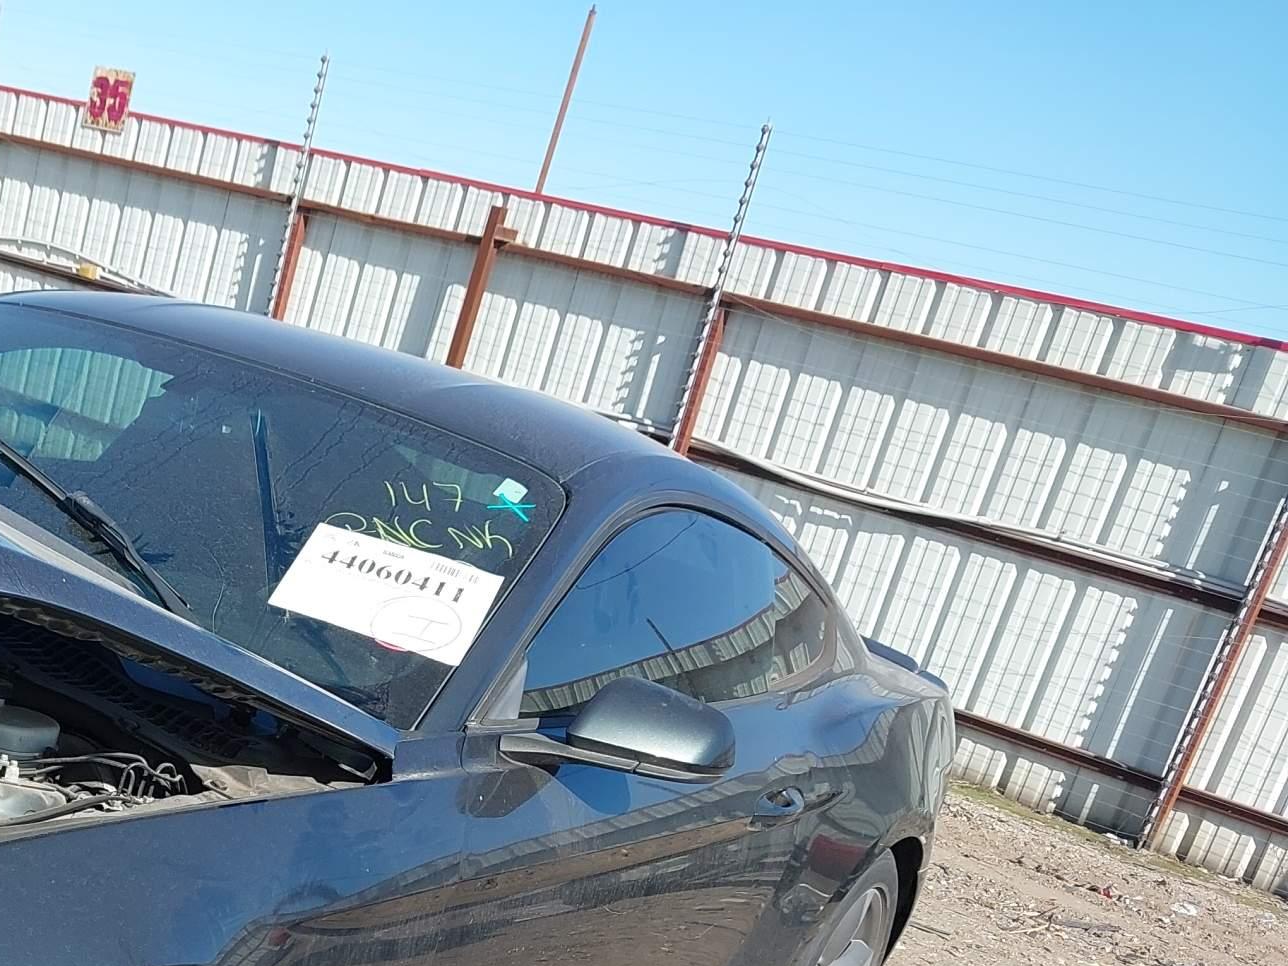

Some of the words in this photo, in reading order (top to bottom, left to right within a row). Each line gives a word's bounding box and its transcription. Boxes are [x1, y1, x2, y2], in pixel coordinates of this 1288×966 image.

[89, 76, 130, 123] 35
[383, 480, 464, 513] 147
[320, 549, 466, 604] 44060411
